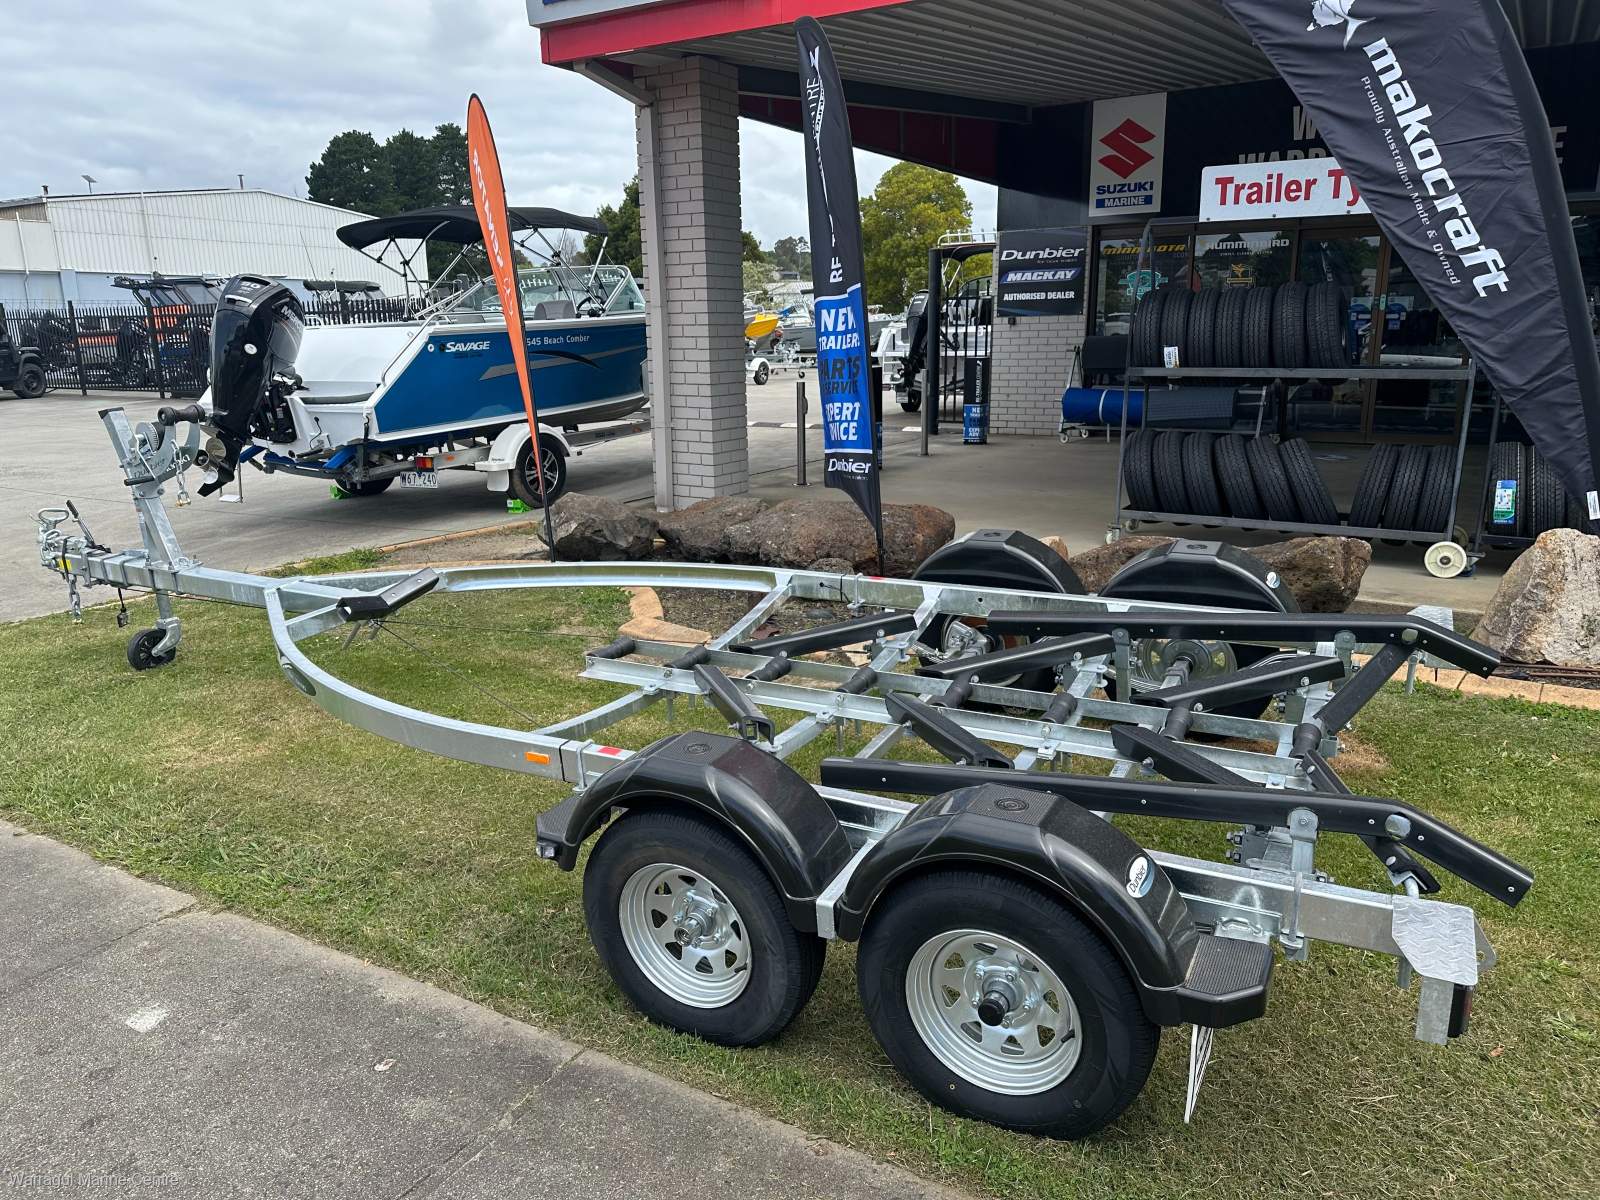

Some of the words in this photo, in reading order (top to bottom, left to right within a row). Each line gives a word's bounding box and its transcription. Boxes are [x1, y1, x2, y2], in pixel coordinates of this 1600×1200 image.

[1363, 37, 1510, 297] makocraft
[1361, 76, 1385, 123] Proudly
[1381, 128, 1413, 189] Australian
[1410, 192, 1430, 225] Made
[1426, 230, 1438, 239] &
[1433, 243, 1461, 284] Owned
[1096, 181, 1154, 195] SUZUKI
[1215, 173, 1318, 206] Trailer
[1104, 196, 1145, 207] MARINE
[1001, 247, 1084, 261] Dunbier
[1007, 270, 1075, 282] MACKAY
[1004, 292, 1046, 301] AUTHORISED
[1047, 291, 1075, 299] DEALER
[544, 336, 564, 345] Beach
[566, 334, 590, 343] Comber
[446, 341, 490, 353] SAVAGE
